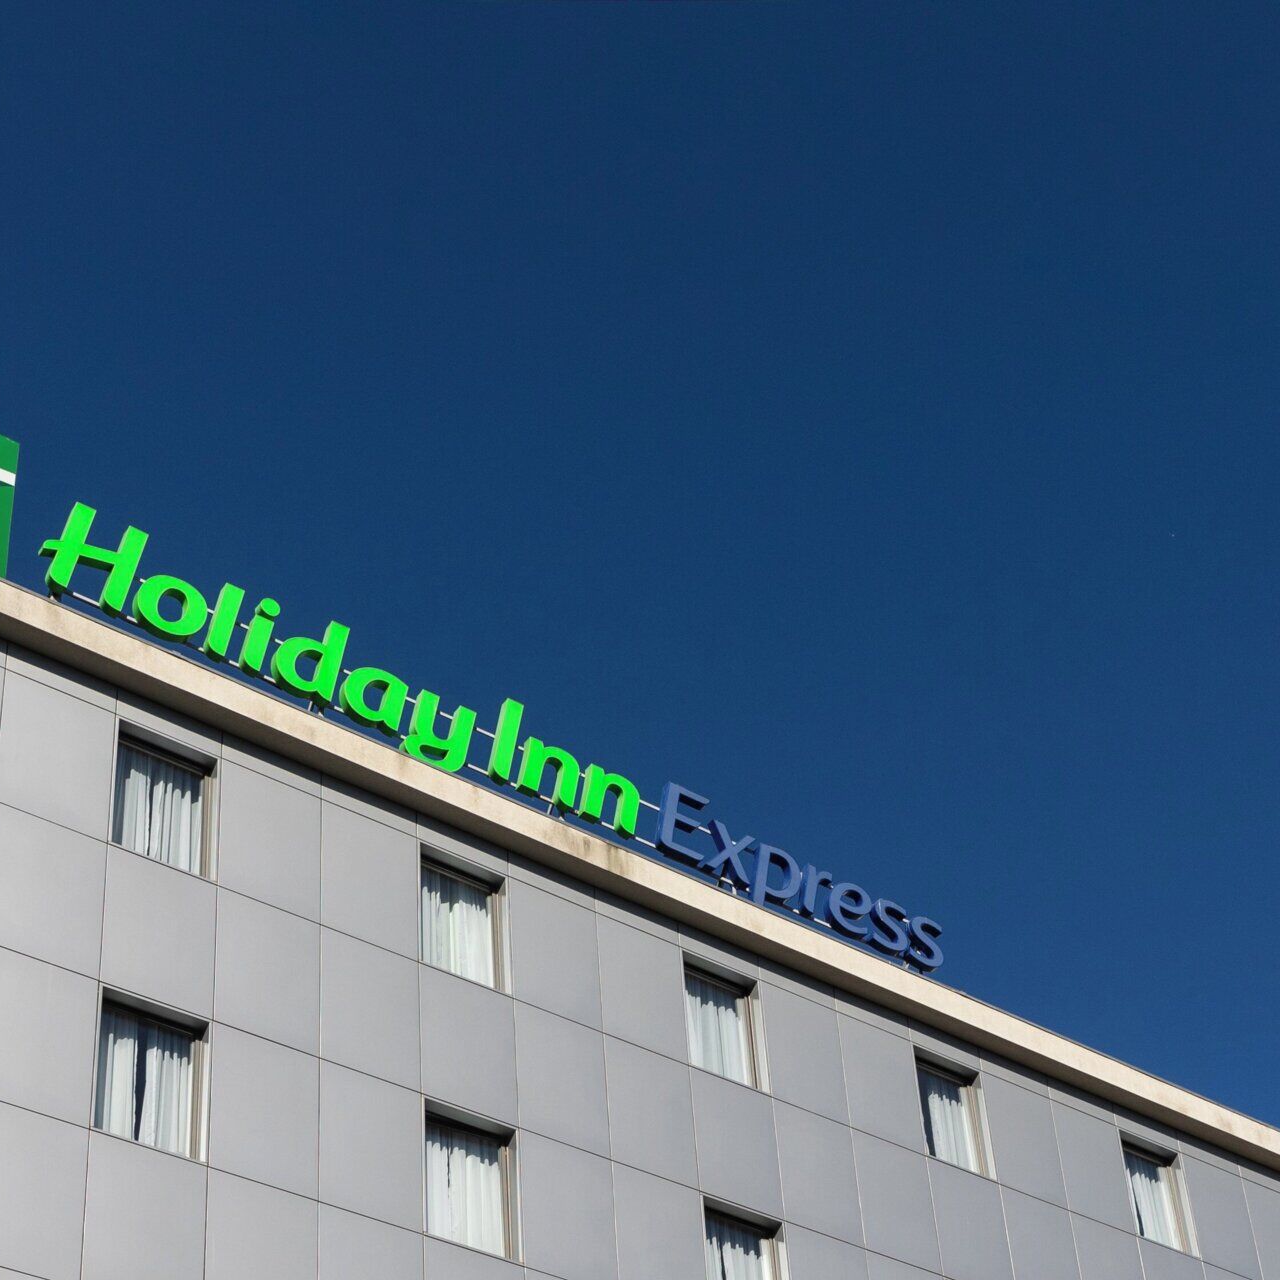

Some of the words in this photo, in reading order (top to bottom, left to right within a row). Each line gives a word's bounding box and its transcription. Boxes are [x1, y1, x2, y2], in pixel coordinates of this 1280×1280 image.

[40, 502, 477, 773] Holiday
[488, 699, 641, 837] Inn
[656, 781, 945, 973] Express
